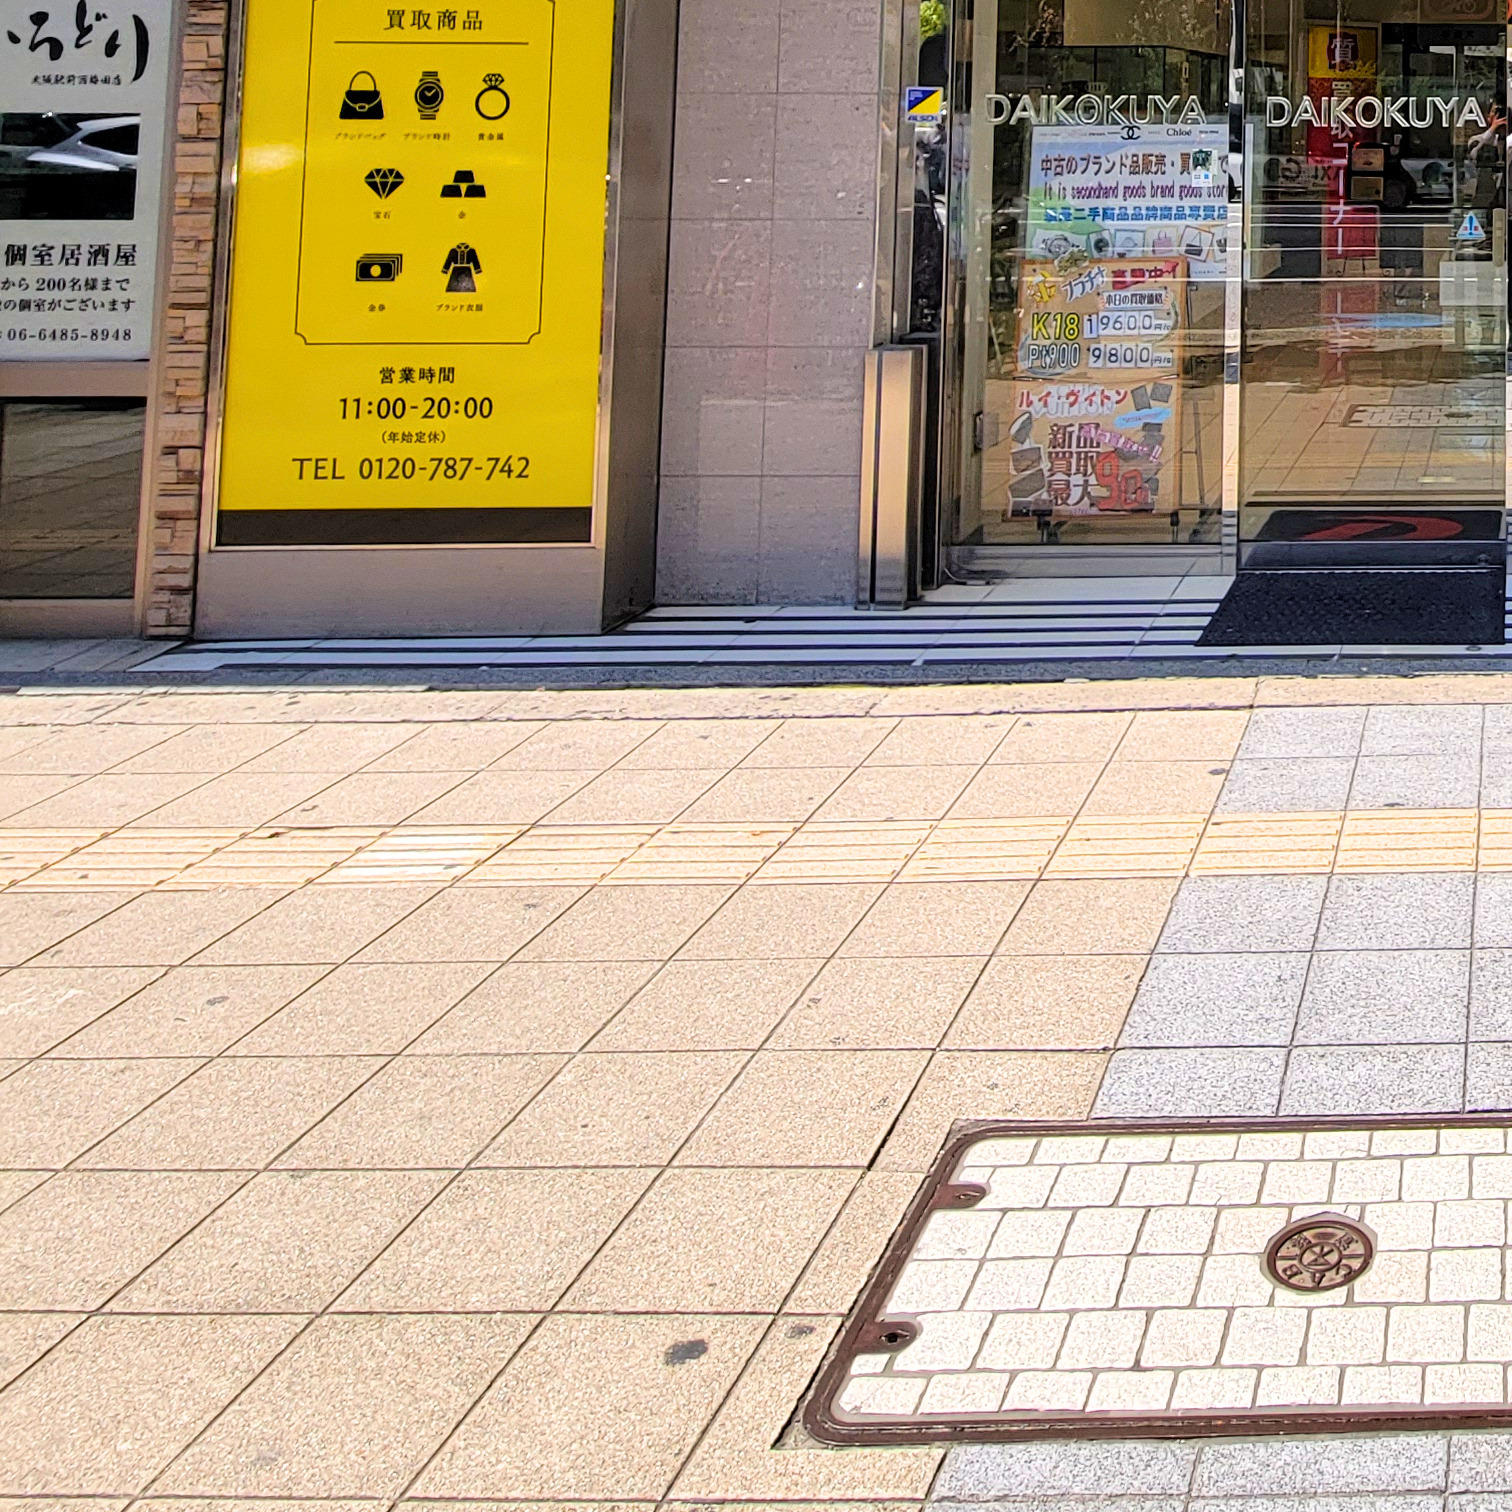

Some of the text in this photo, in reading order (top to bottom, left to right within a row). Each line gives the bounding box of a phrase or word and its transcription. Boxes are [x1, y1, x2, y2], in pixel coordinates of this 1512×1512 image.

[383, 8, 484, 31] 買取商品
[984, 93, 1207, 126] DAIKOKUYA
[1265, 95, 1487, 129] DAIKOKUYA
[1166, 127, 1192, 137] Chloé
[1150, 180, 1176, 200] brand
[372, 210, 392, 220] 宝石
[4, 243, 138, 267] 個室居酒屋
[0, 297, 136, 313] の個室がございます
[367, 303, 387, 313] 金券
[435, 303, 484, 313] ブランド衣服
[7, 327, 132, 342] 06-6485-8948
[1030, 311, 1081, 342] K18
[1091, 346, 1151, 365] 9800
[378, 366, 456, 385] 営業時間
[338, 396, 494, 421] 11:00-20:00
[291, 456, 531, 481] TEL 0120-787-742
